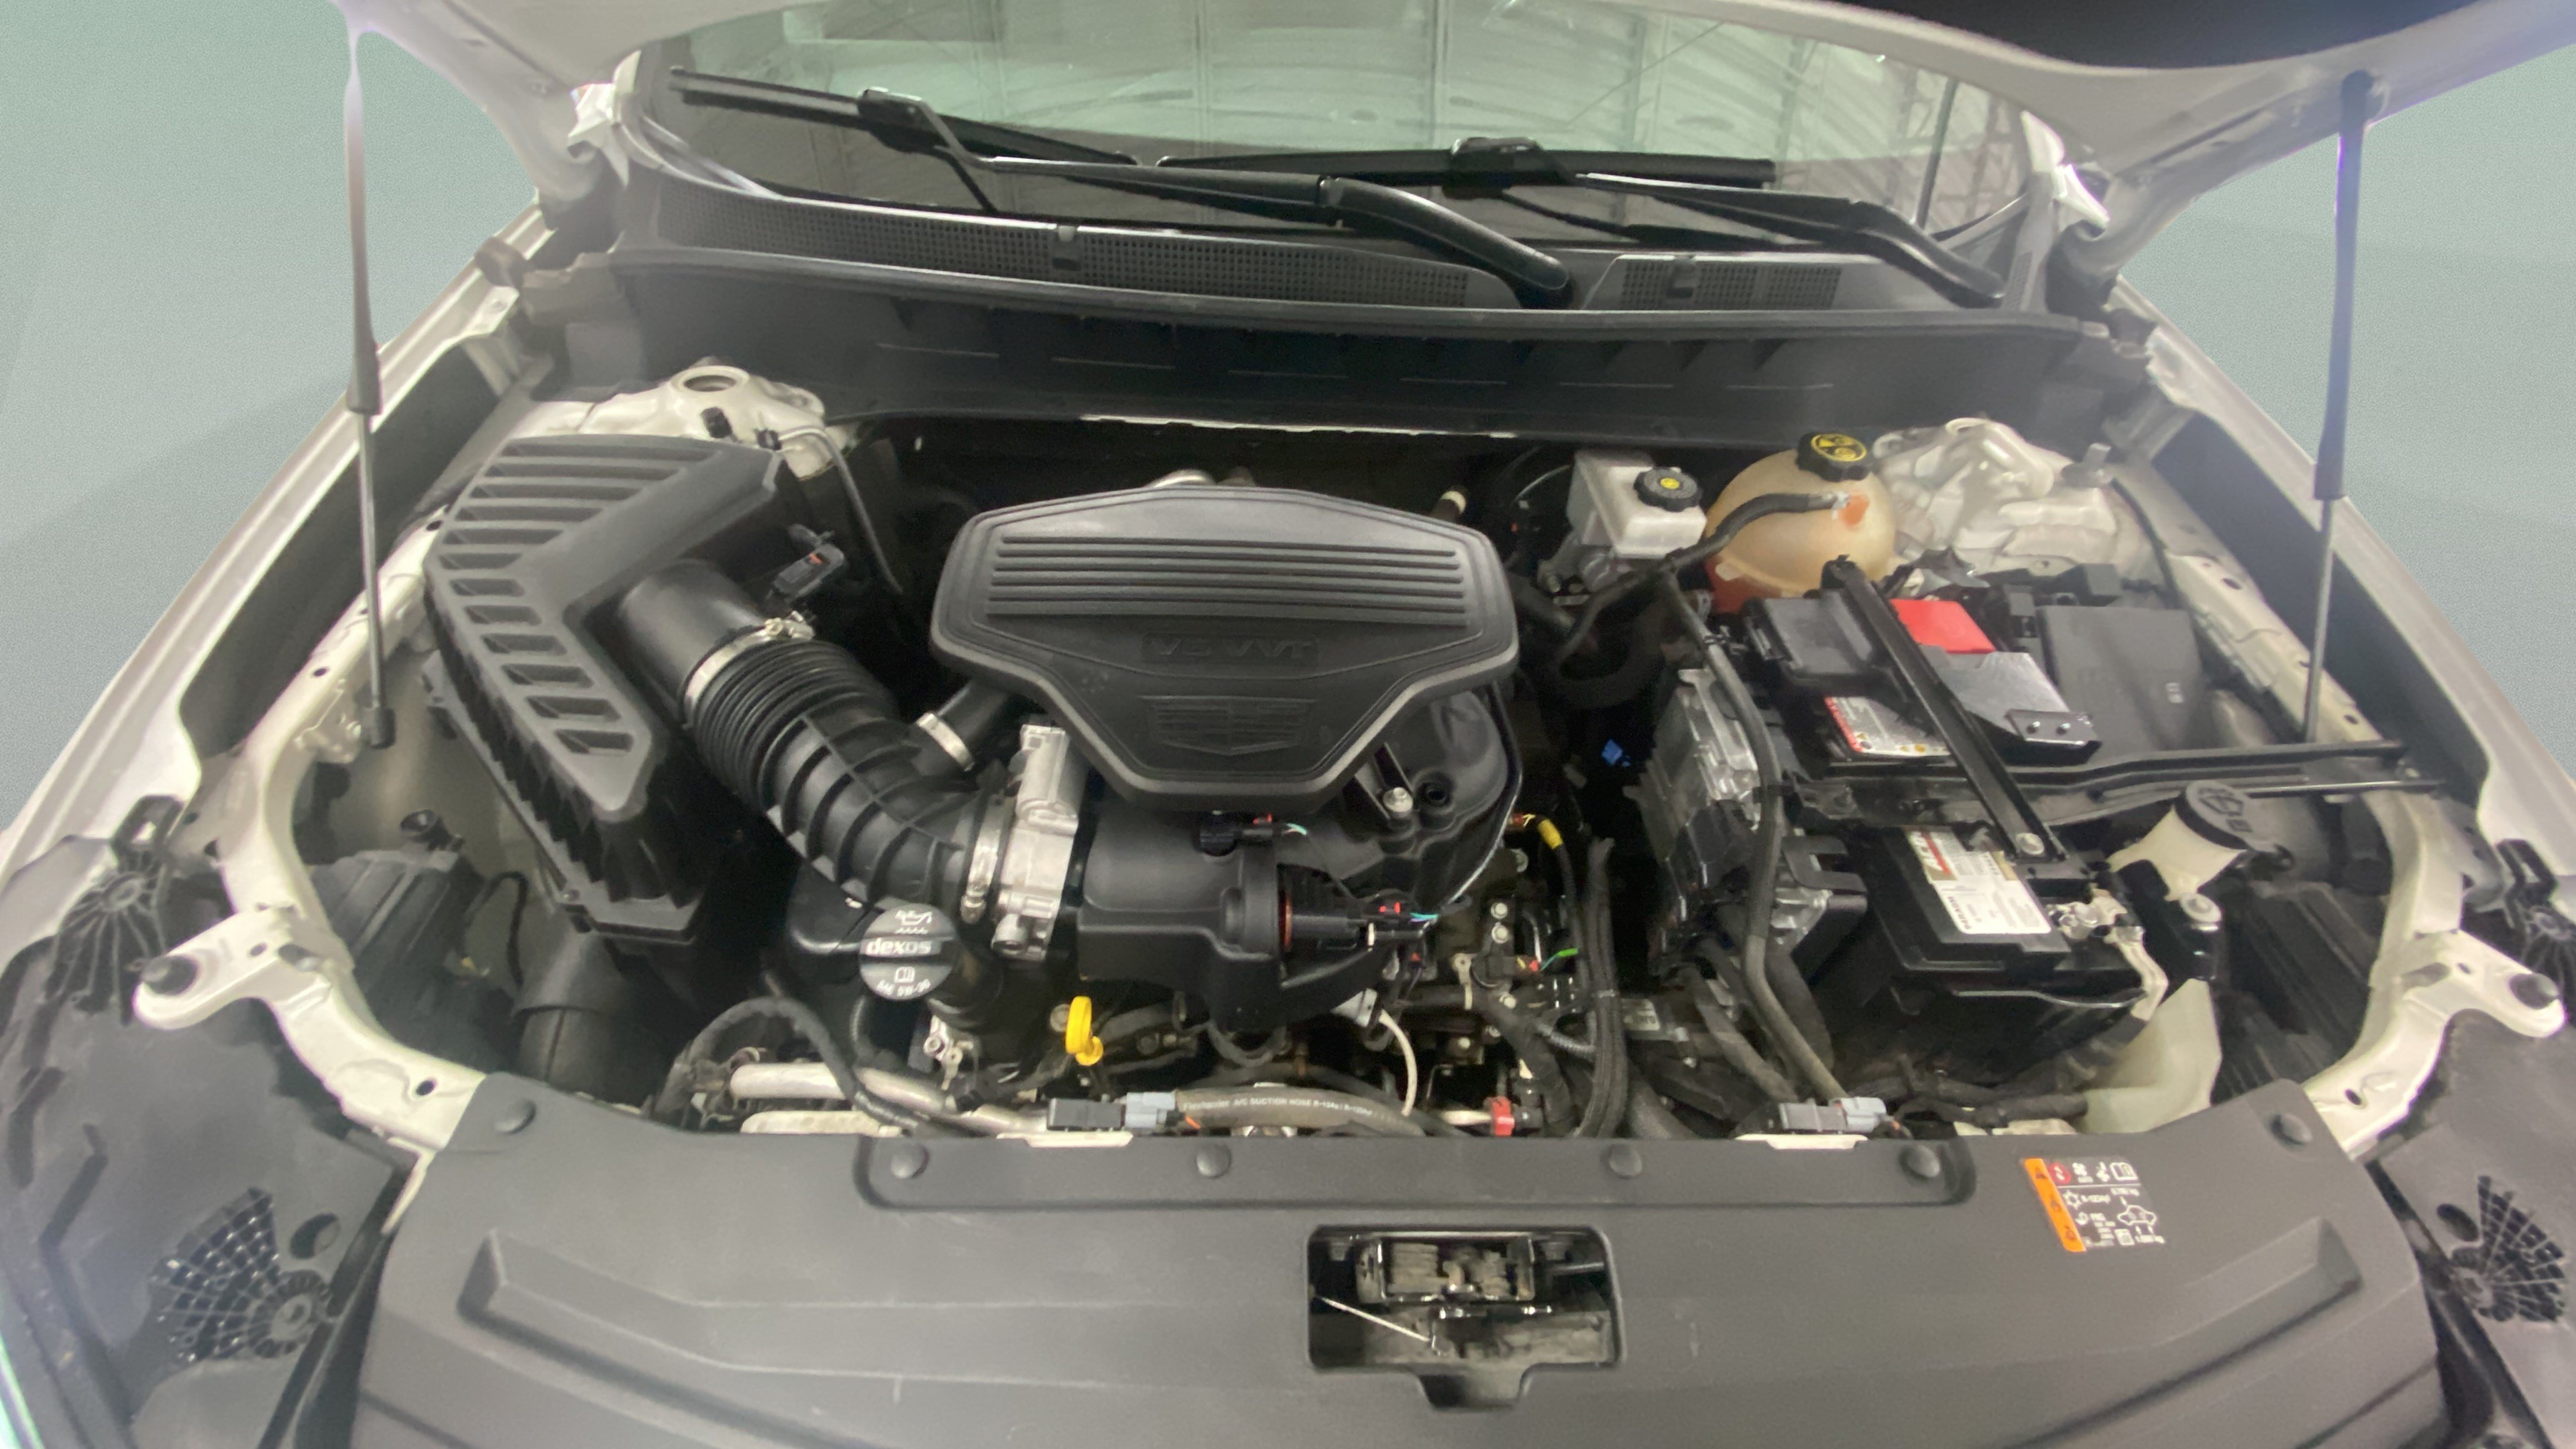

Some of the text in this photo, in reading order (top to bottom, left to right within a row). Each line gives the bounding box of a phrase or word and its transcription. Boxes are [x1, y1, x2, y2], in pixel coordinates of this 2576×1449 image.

[1223, 637, 1312, 658] VVT
[866, 937, 932, 957] dexos
[1233, 1097, 1248, 1106] A/C
[1250, 1097, 1287, 1106] SUCTION
[1289, 1098, 1312, 1107] HOSE
